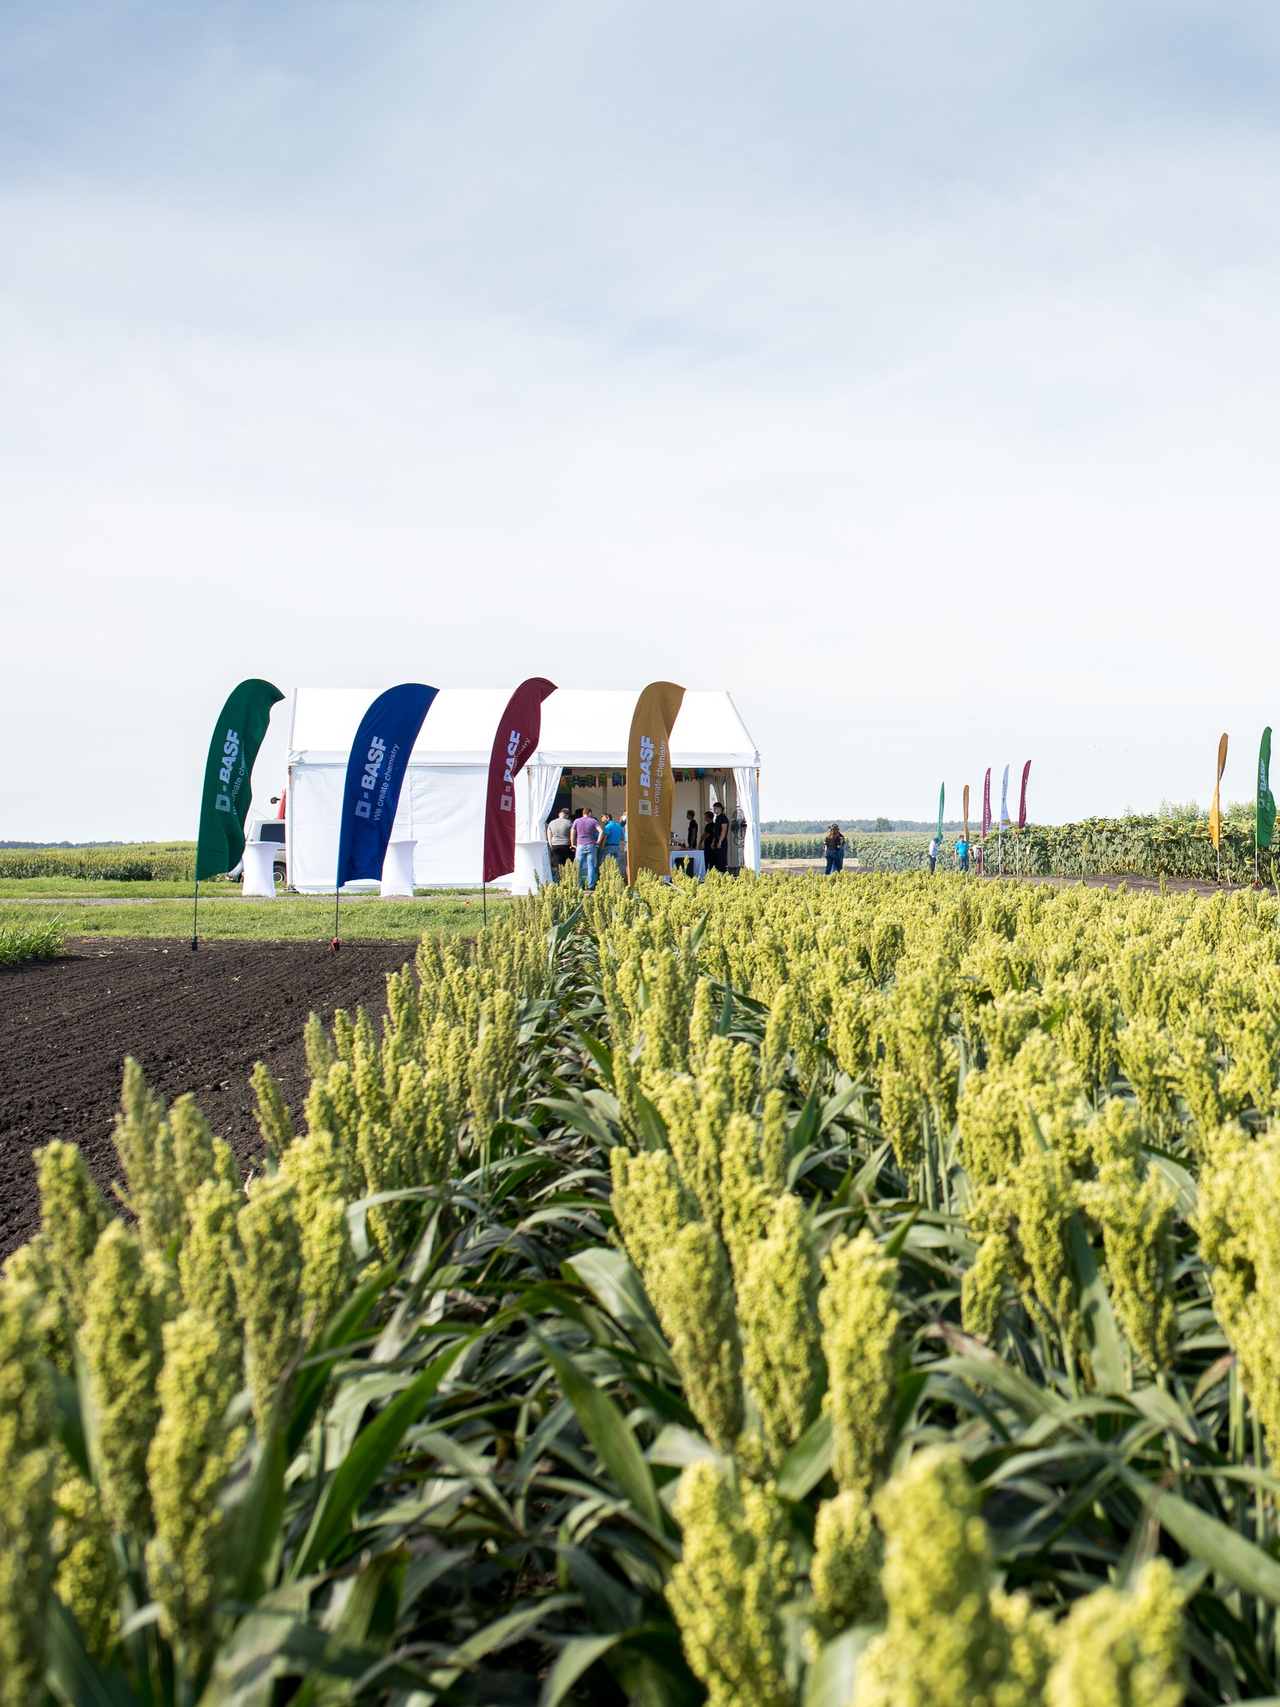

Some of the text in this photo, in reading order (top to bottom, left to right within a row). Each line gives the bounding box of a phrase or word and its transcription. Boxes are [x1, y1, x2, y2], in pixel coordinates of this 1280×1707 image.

[219, 728, 240, 784] BASF
[361, 735, 387, 790] BASF
[373, 743, 400, 821] We create chemistry
[503, 729, 521, 784] BASF
[640, 734, 654, 788] BASF
[654, 805, 659, 817] We
[657, 739, 666, 777] chemistry
